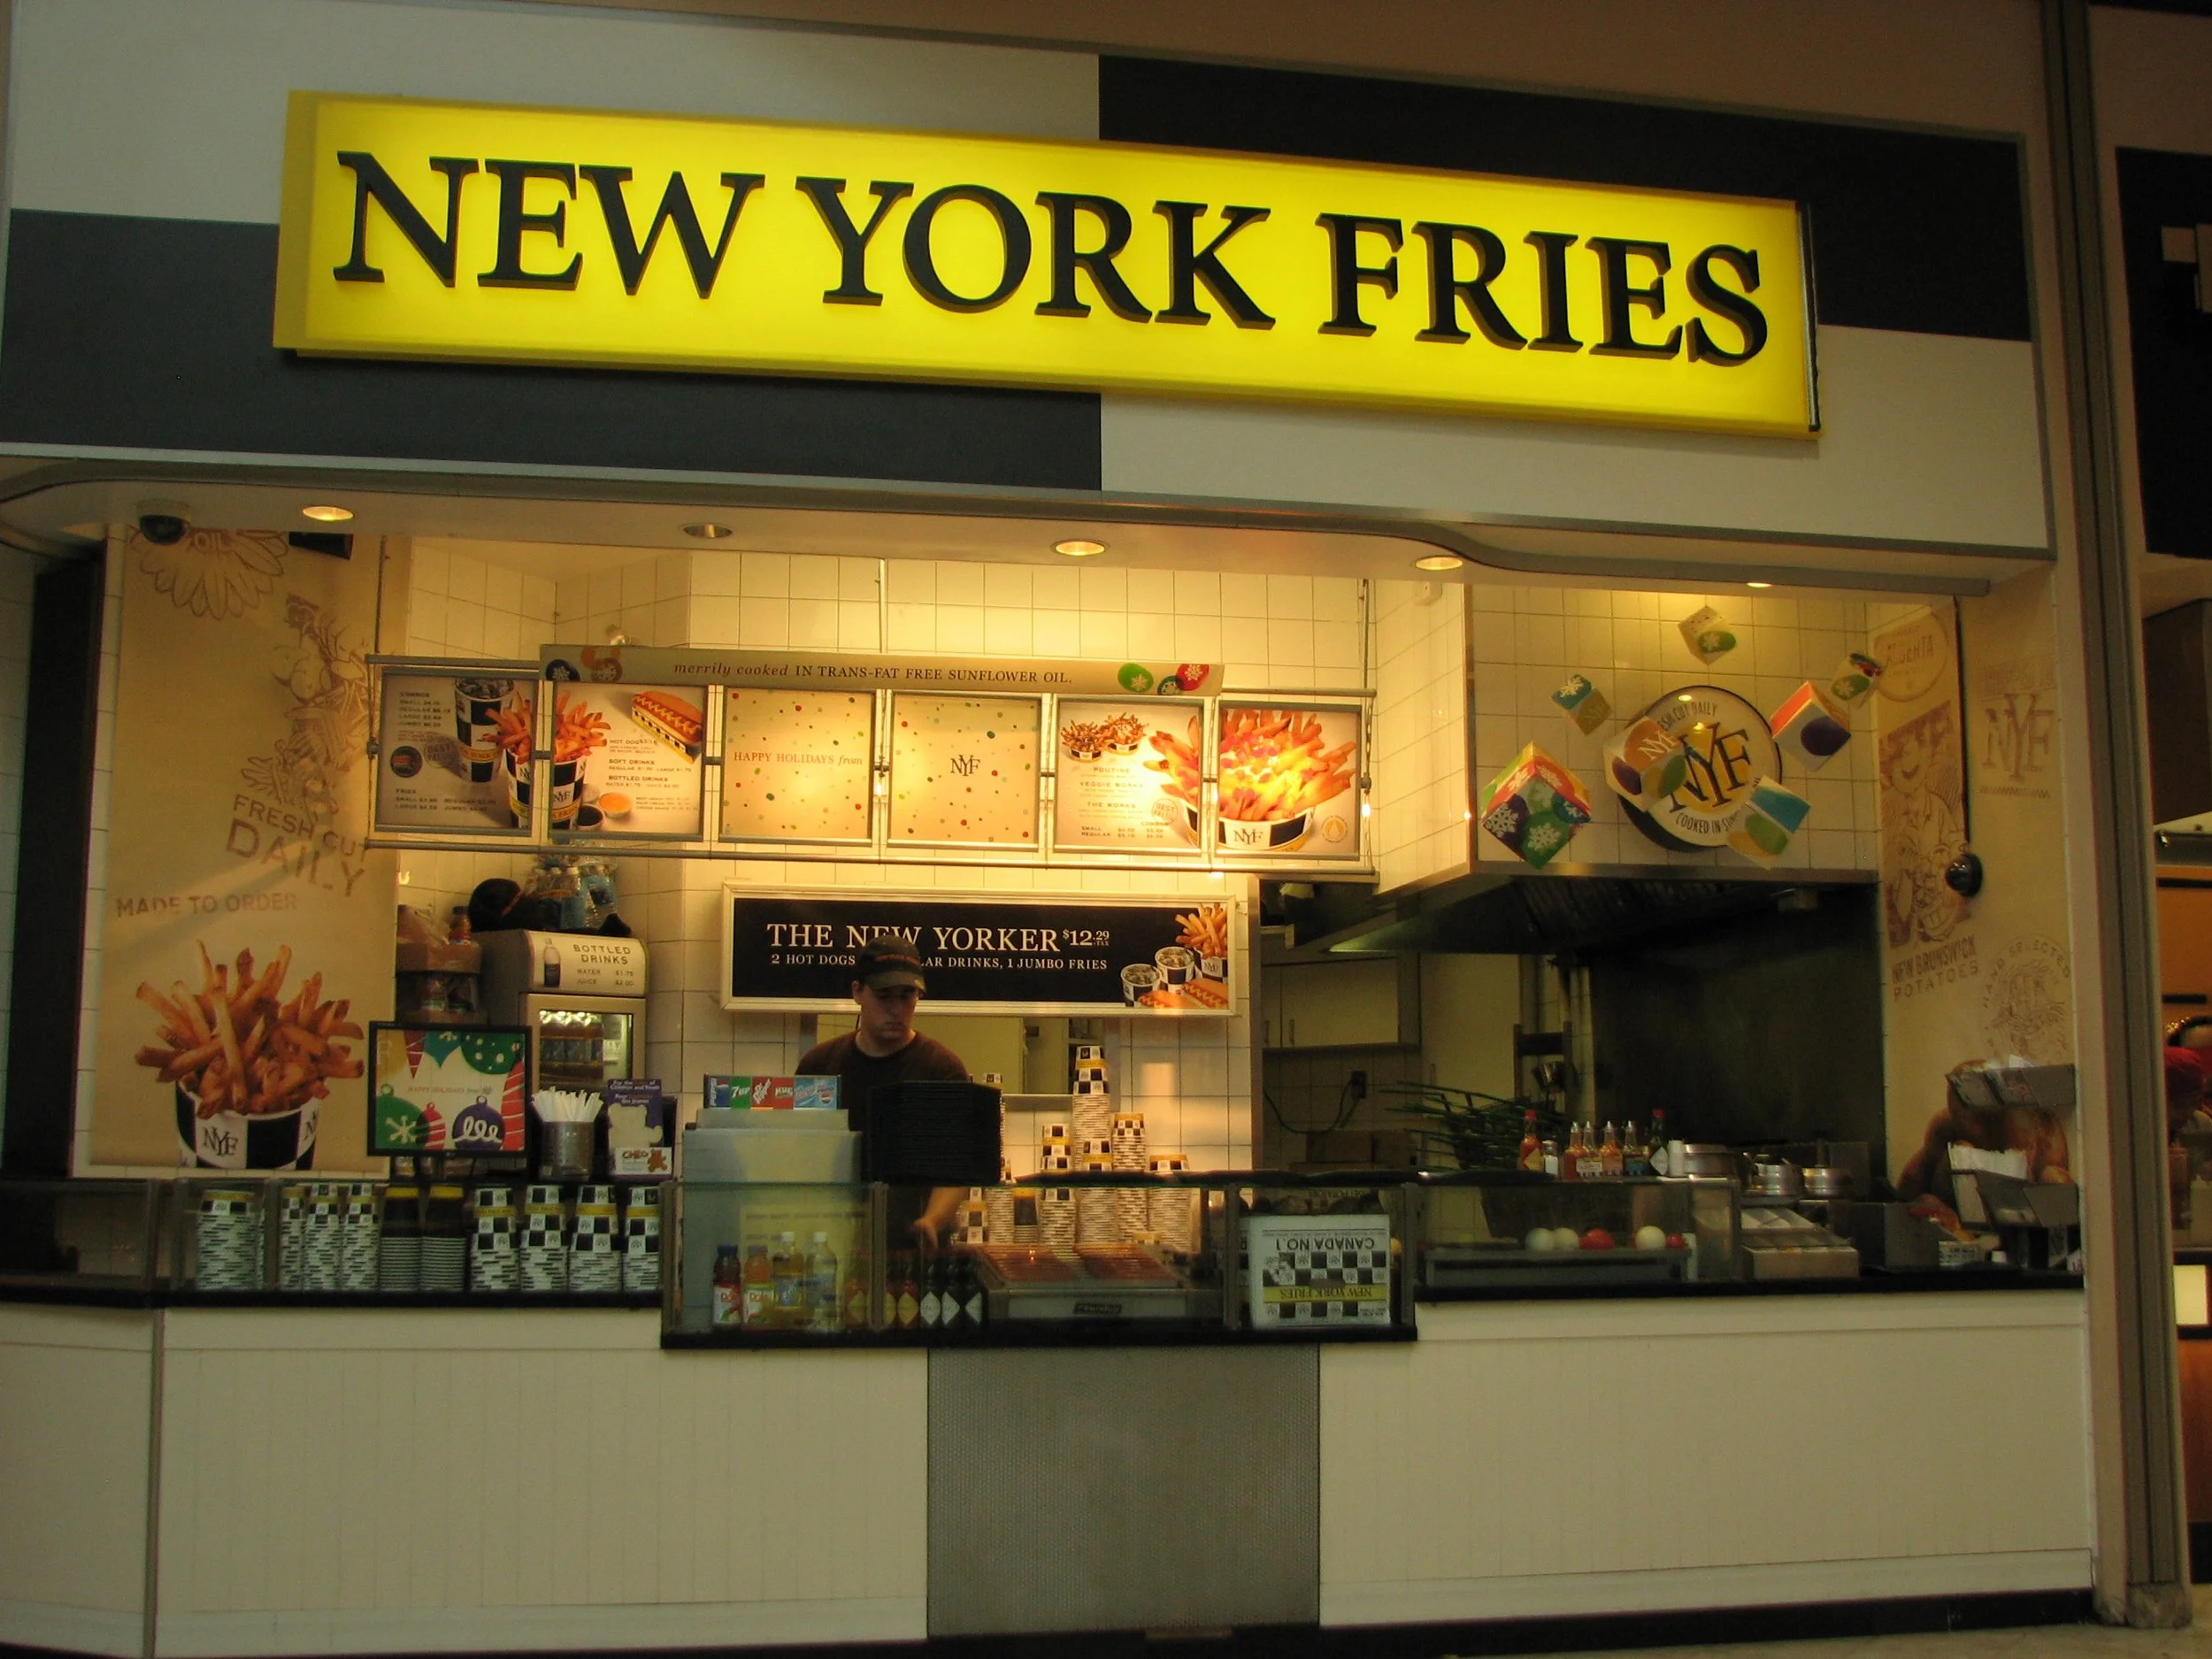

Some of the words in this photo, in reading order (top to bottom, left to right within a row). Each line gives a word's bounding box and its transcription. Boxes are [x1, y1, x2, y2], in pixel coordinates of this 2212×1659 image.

[334, 150, 765, 300] NEW
[795, 176, 1276, 331] YORK
[1315, 212, 1769, 367] FRIES
[674, 662, 731, 678] merrily
[737, 664, 788, 677] cooked
[795, 665, 813, 677] IN
[818, 665, 900, 680] TRANS-FAT
[905, 668, 943, 680] FREE
[948, 669, 1038, 683] SUNFLOWER
[1043, 671, 1072, 684] OIL.
[733, 751, 772, 764] HAPPY
[776, 752, 834, 764] HOLIDAYS
[837, 754, 864, 767] from
[950, 754, 980, 777] NYF
[234, 795, 315, 839] FRESH
[1675, 812, 1709, 833] COOKED
[1233, 828, 1263, 845] NYF
[226, 818, 365, 897] DAILY
[117, 897, 182, 918] MADE
[189, 895, 219, 915] TO
[226, 893, 298, 914] ORDER
[767, 923, 833, 948] THE
[933, 927, 1061, 952] YORKER
[572, 944, 631, 955] BOTTLED
[580, 954, 629, 964] DRINKS
[771, 954, 780, 964] 2
[786, 954, 814, 964] HOT
[819, 955, 856, 965] DOGS
[1916, 934, 1976, 976] BRUNSWICK
[1008, 958, 1013, 968] 1
[1017, 959, 1064, 969] JUMBO
[1069, 960, 1107, 970] FRIES
[1893, 960, 1979, 1002] POTATOES
[203, 1126, 239, 1156] NYF
[1314, 1237, 1374, 1250] CANADA
[1280, 1287, 1312, 1299] FRIES
[1348, 1286, 1371, 1298] NEW
